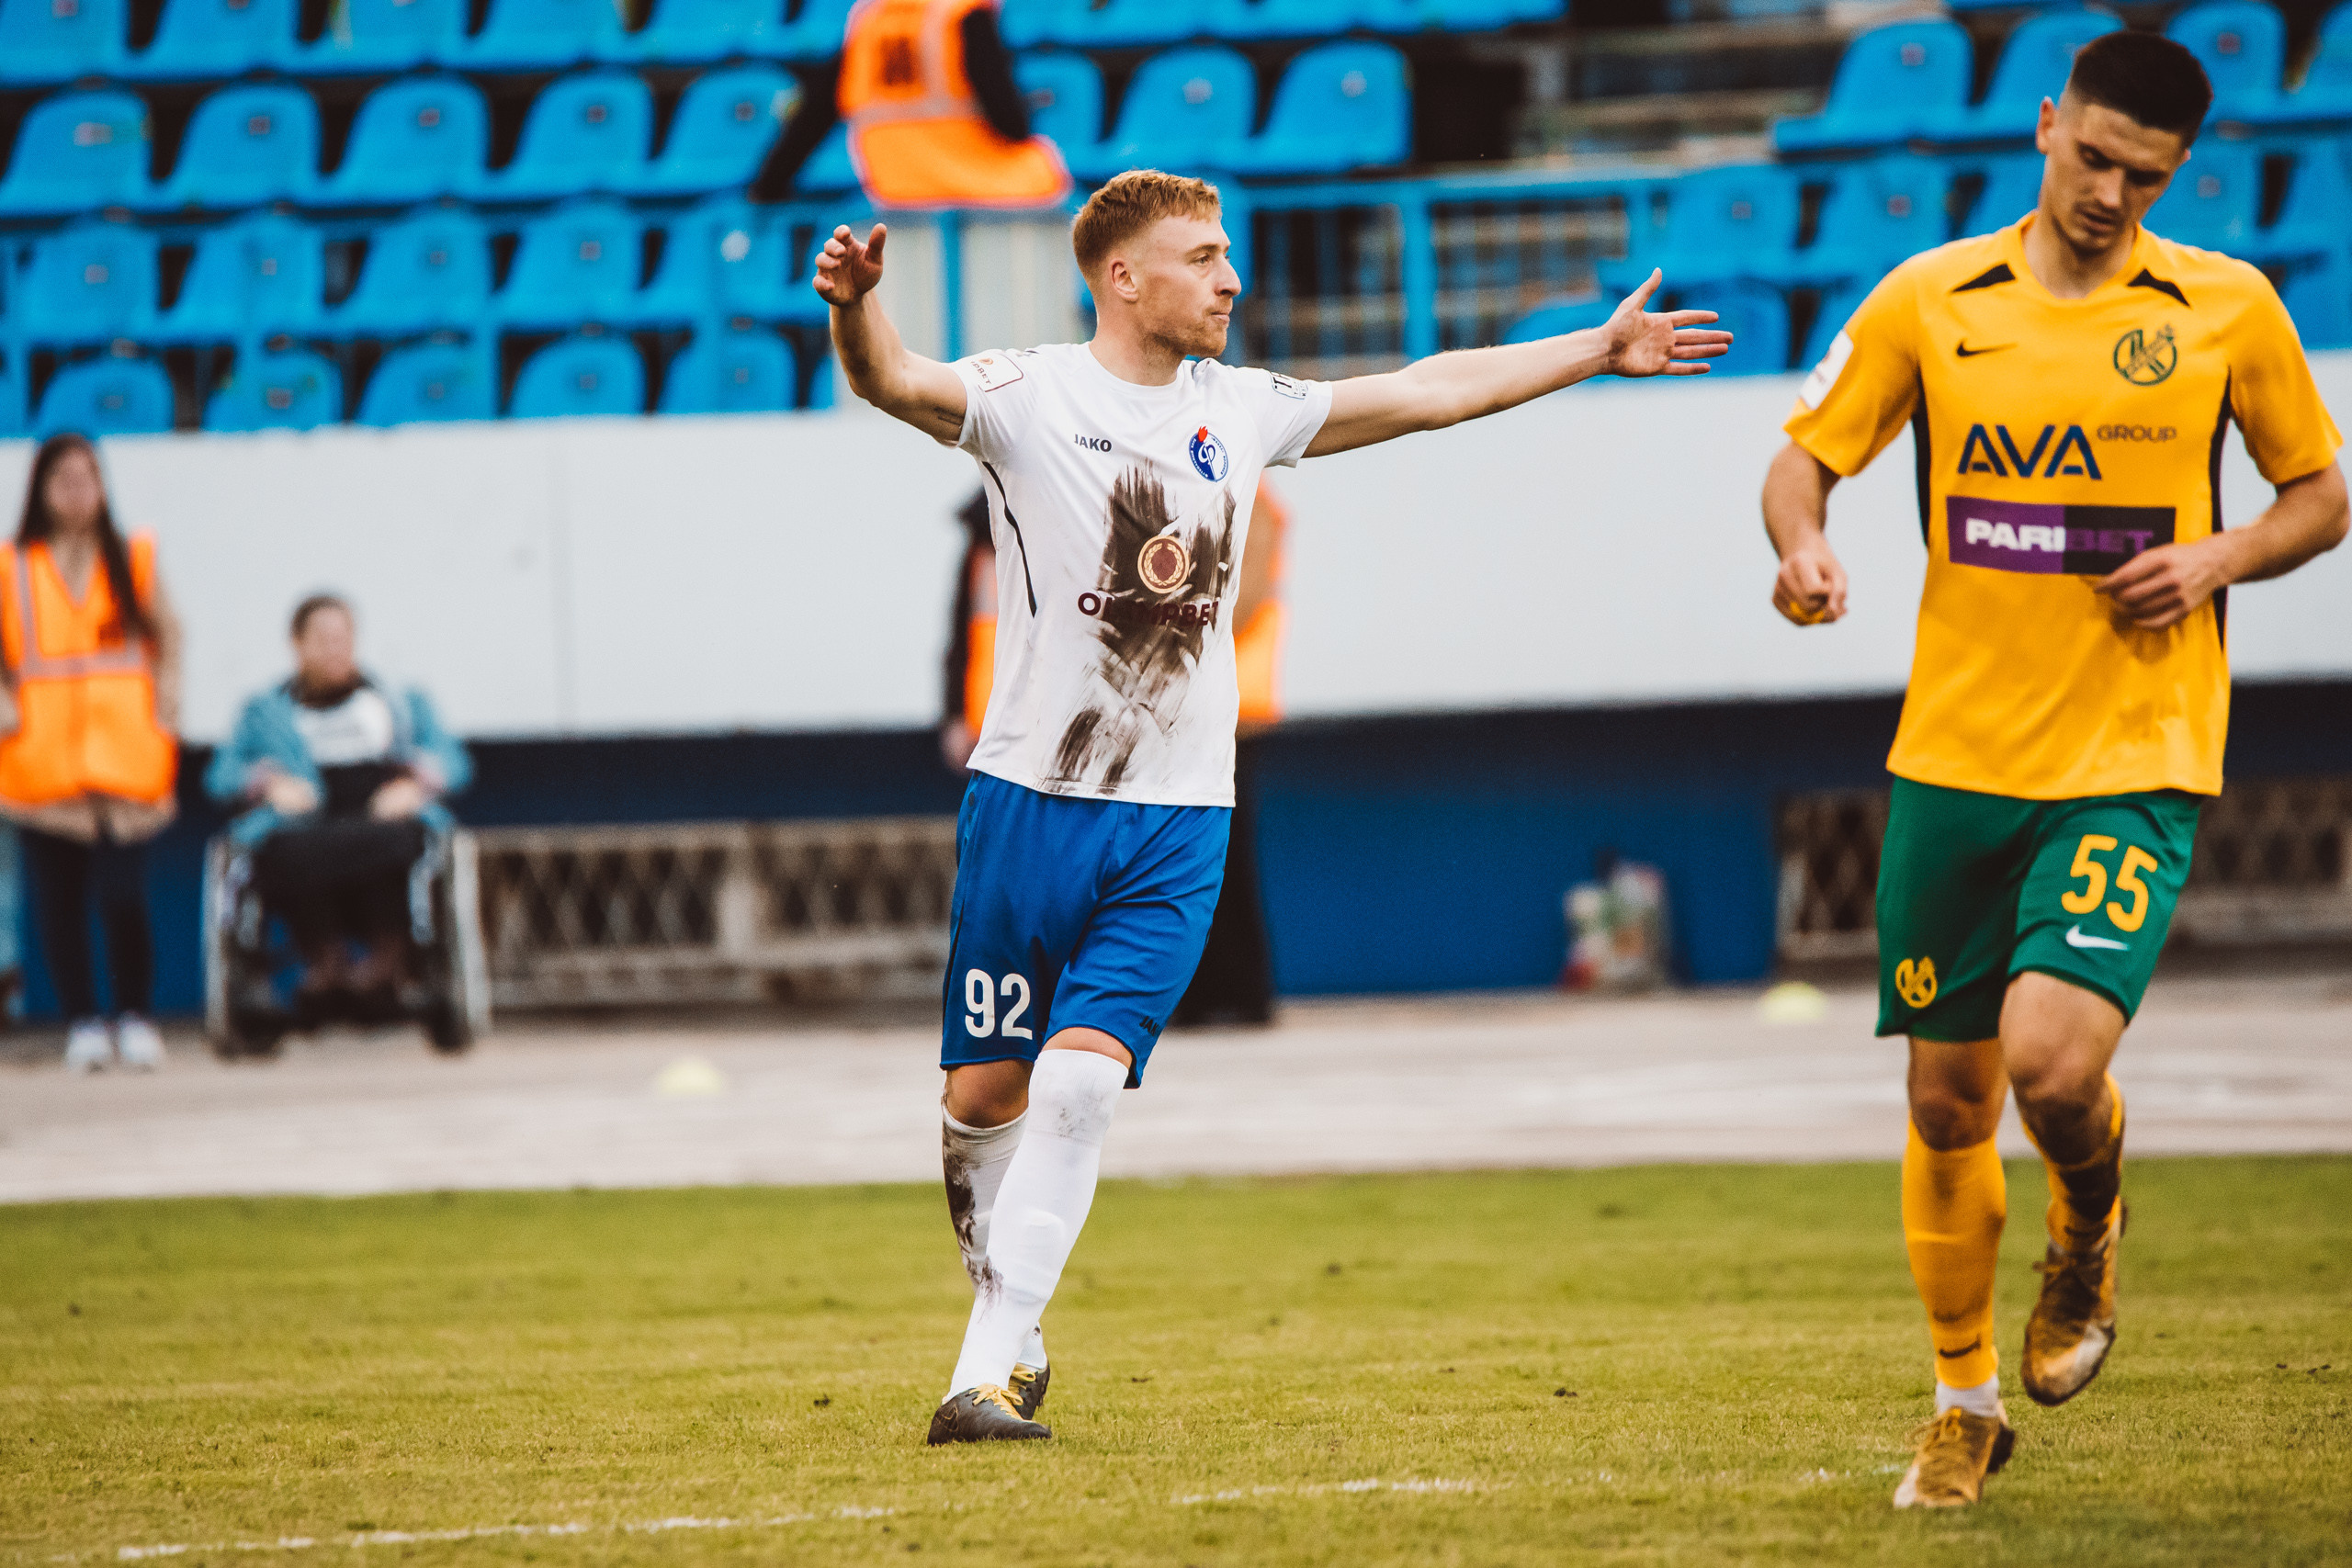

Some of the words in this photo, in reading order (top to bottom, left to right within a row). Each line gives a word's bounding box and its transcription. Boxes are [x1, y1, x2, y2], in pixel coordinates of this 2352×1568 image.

[1074, 434, 1112, 452] JAKO
[1957, 423, 2102, 480] AVA
[2097, 424, 2177, 443] GROUP
[2062, 834, 2157, 932] 55
[965, 968, 1033, 1040] 92
[1139, 1015, 1161, 1037] JAK
